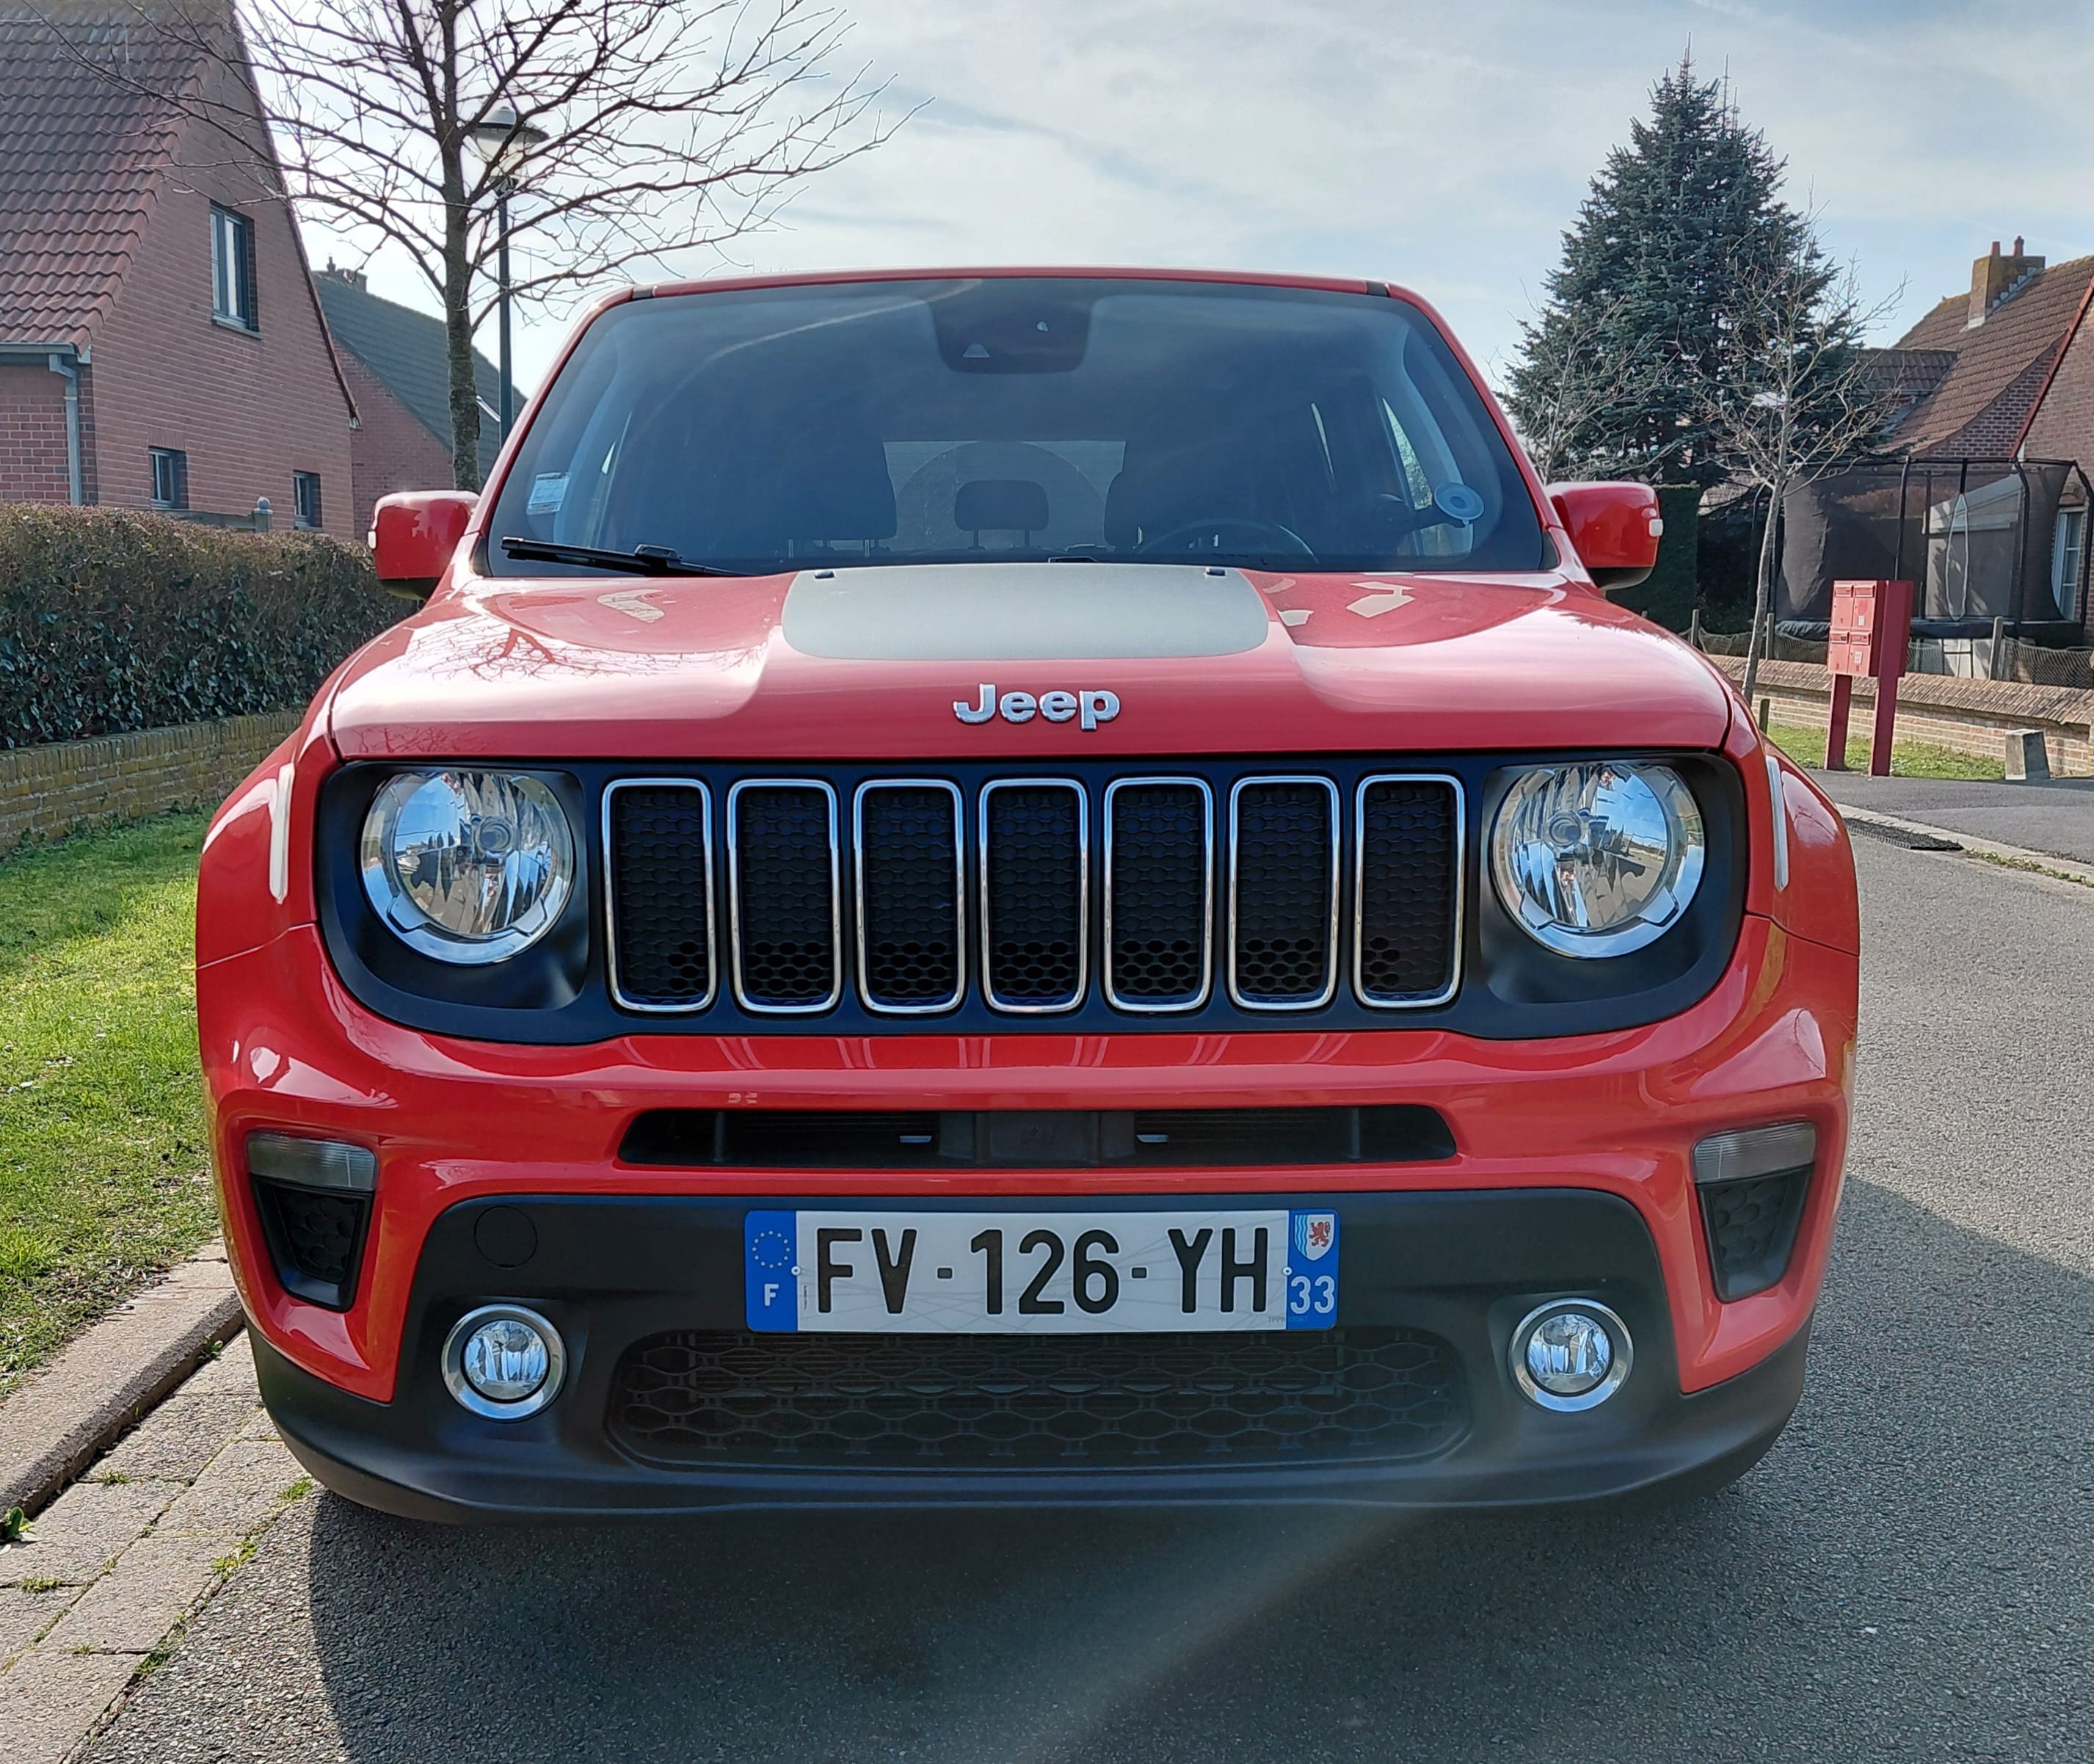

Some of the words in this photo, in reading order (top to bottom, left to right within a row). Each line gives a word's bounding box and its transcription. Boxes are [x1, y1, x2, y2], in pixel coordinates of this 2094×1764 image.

[953, 683, 1120, 731] Jeep
[763, 1283, 779, 1307] F
[1290, 1275, 1335, 1315] 33
